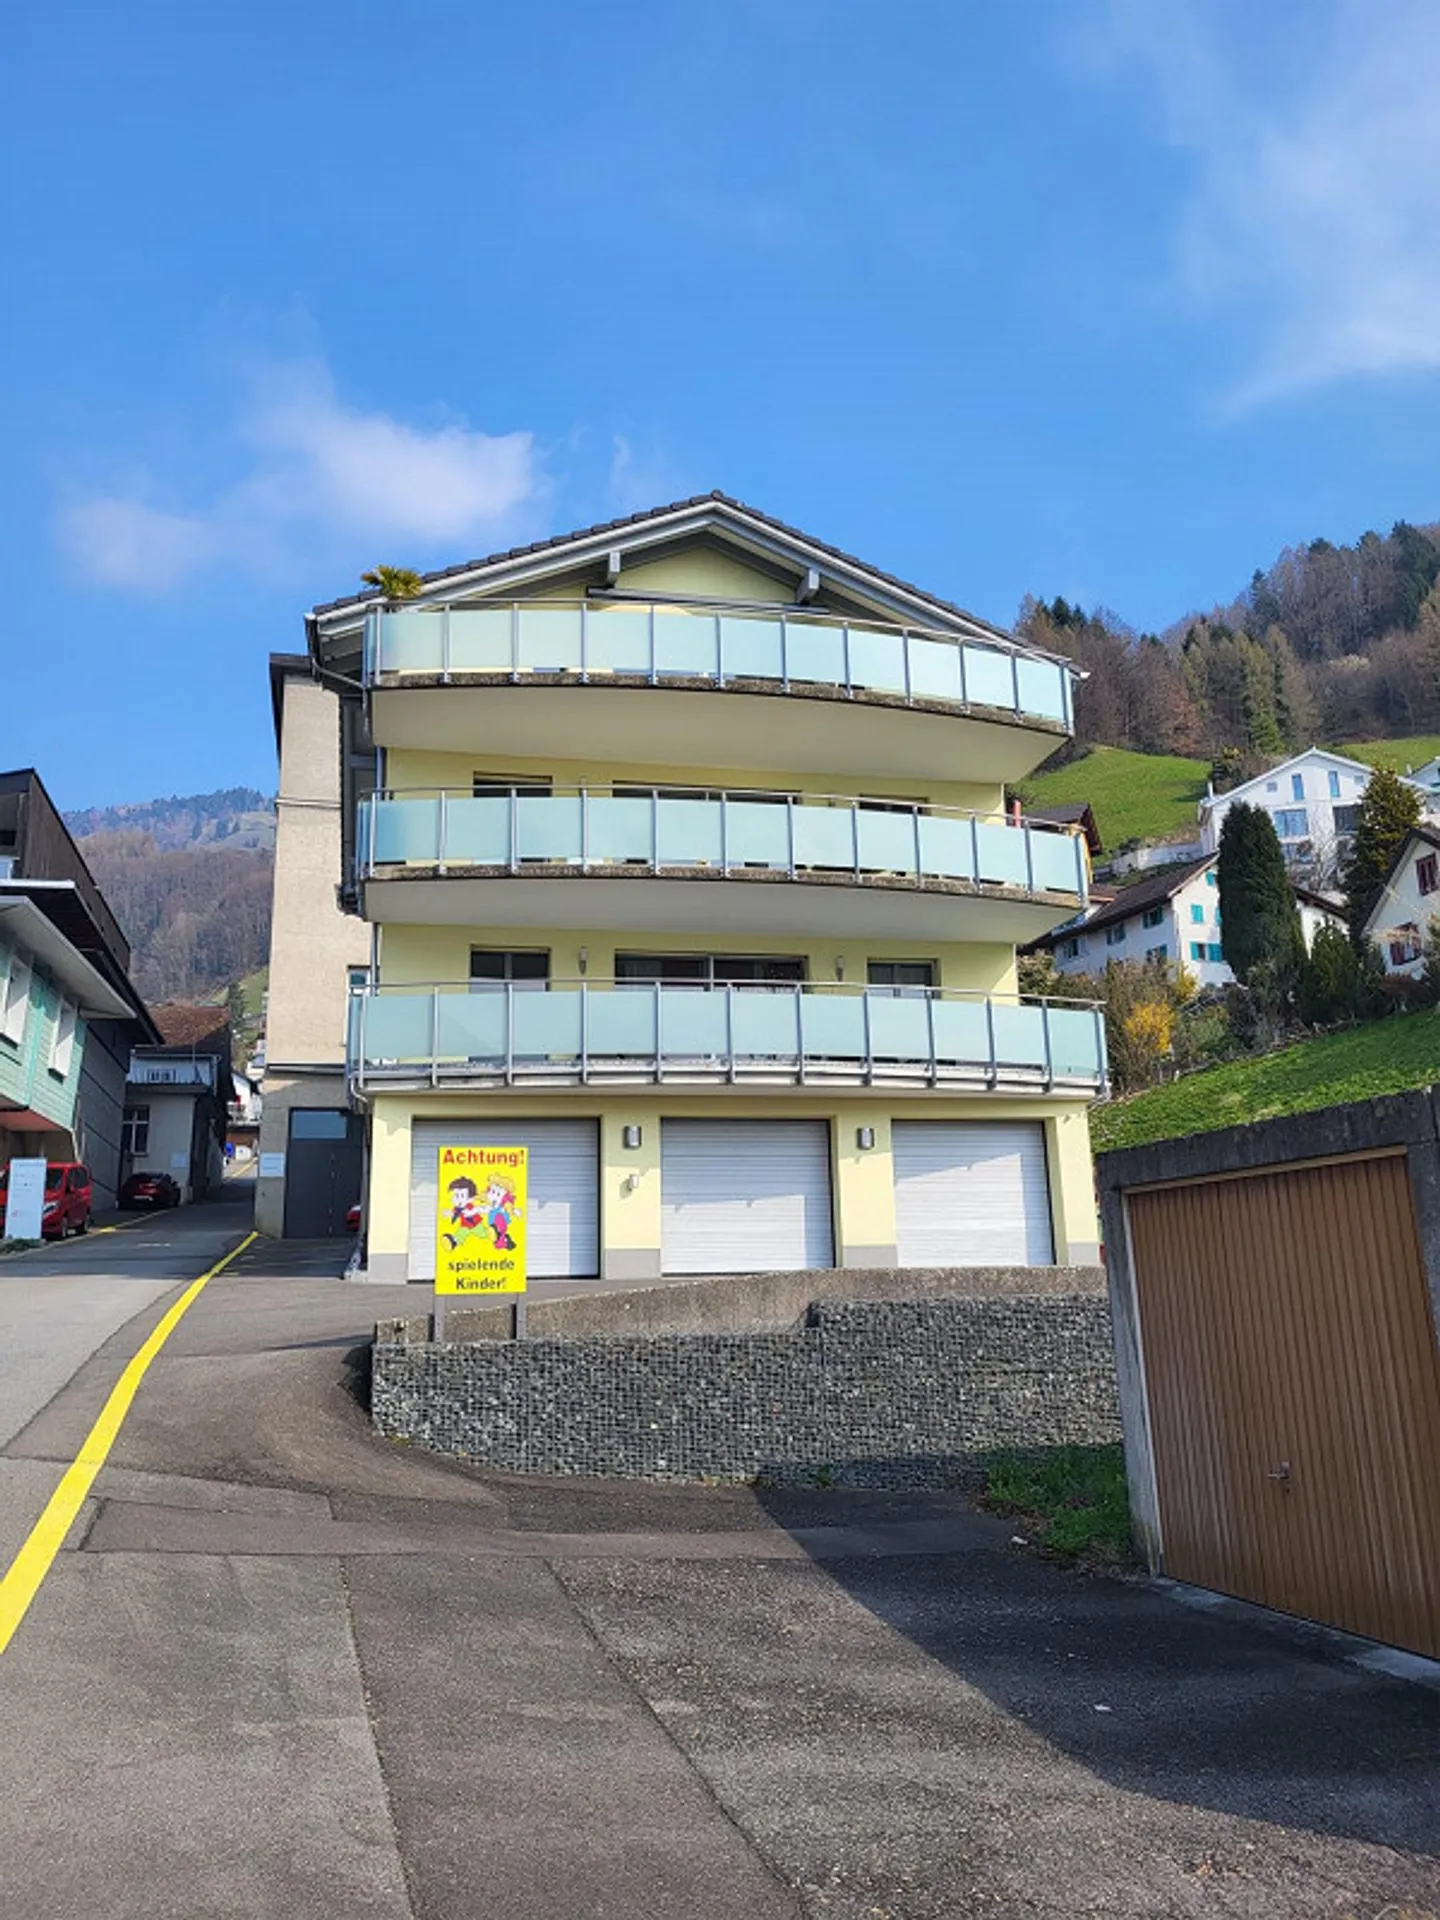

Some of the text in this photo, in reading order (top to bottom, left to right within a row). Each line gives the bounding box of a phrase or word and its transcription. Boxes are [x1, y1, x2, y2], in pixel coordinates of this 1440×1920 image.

[443, 1150, 525, 1167] Achtung!
[448, 1258, 515, 1272] spielende
[456, 1277, 507, 1290] Kinder!
